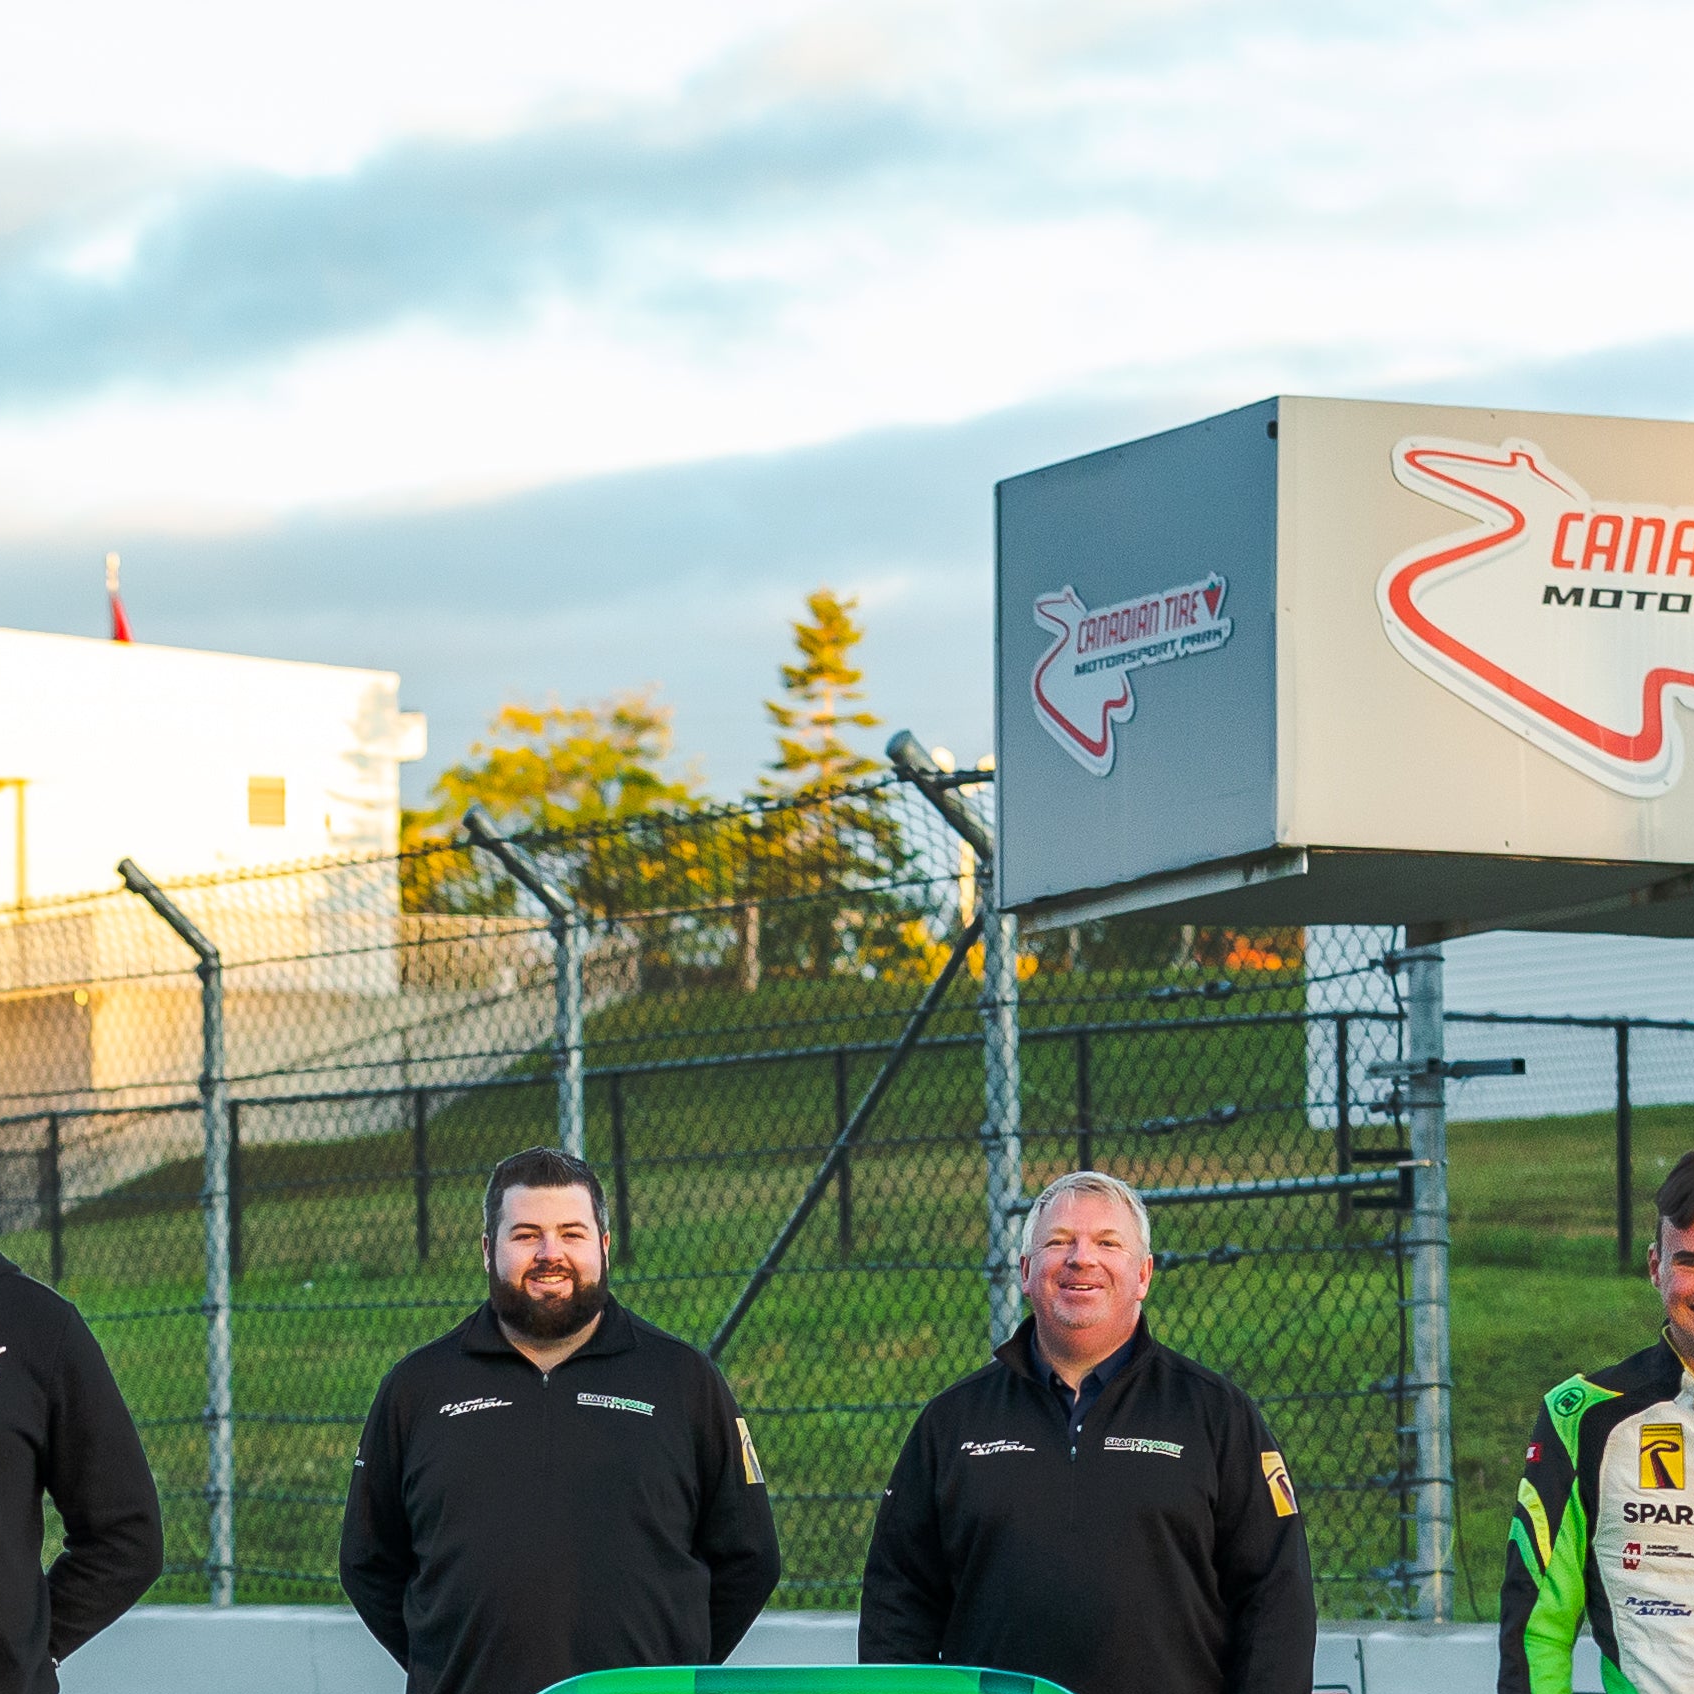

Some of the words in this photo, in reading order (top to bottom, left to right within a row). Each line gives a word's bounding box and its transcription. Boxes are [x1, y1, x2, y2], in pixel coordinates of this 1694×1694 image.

[1077, 600, 1160, 655] CANADIAN
[1164, 589, 1200, 633] TIRE
[1074, 638, 1177, 677] MOTORSPORT
[1180, 628, 1223, 648] PARK
